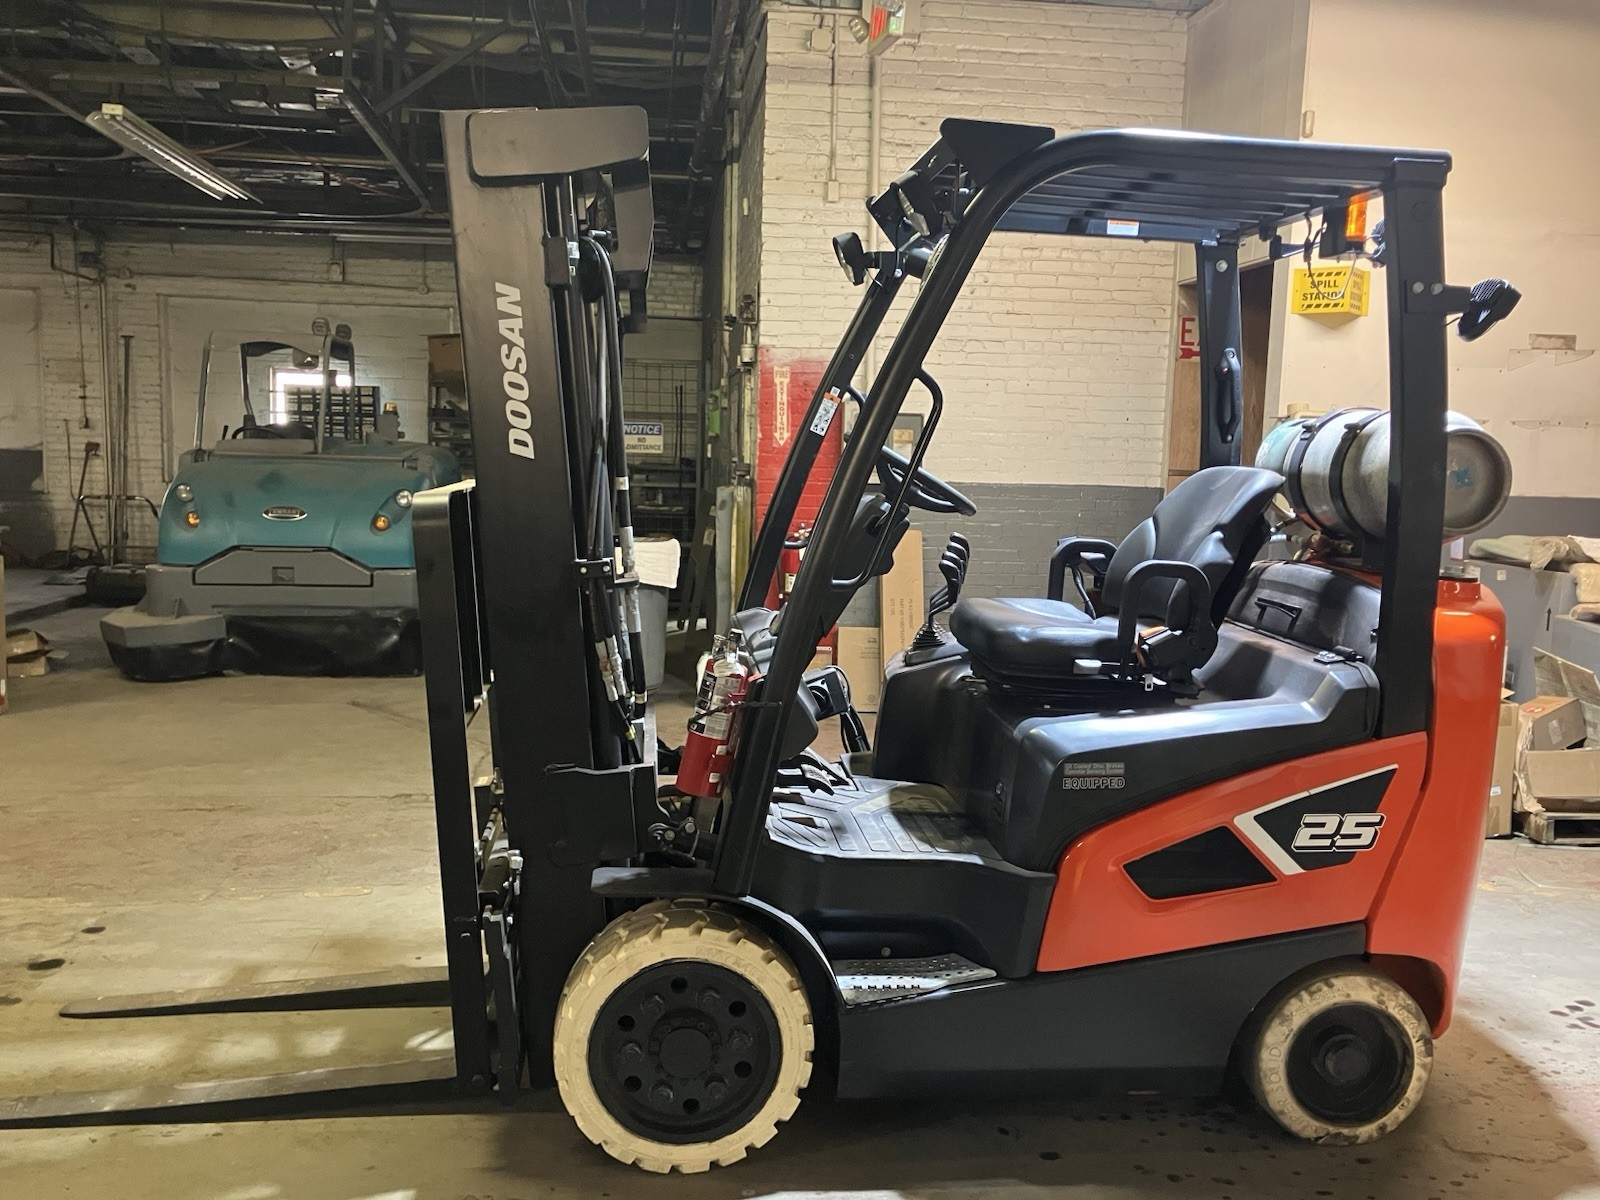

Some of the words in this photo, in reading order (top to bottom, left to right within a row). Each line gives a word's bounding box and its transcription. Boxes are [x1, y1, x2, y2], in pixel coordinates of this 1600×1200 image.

[1310, 280, 1339, 289] SPILL
[495, 282, 535, 460] DOOSAN
[624, 425, 661, 434] NOTICE
[1062, 777, 1125, 789] EQUIPPED
[1291, 813, 1386, 852] 25
